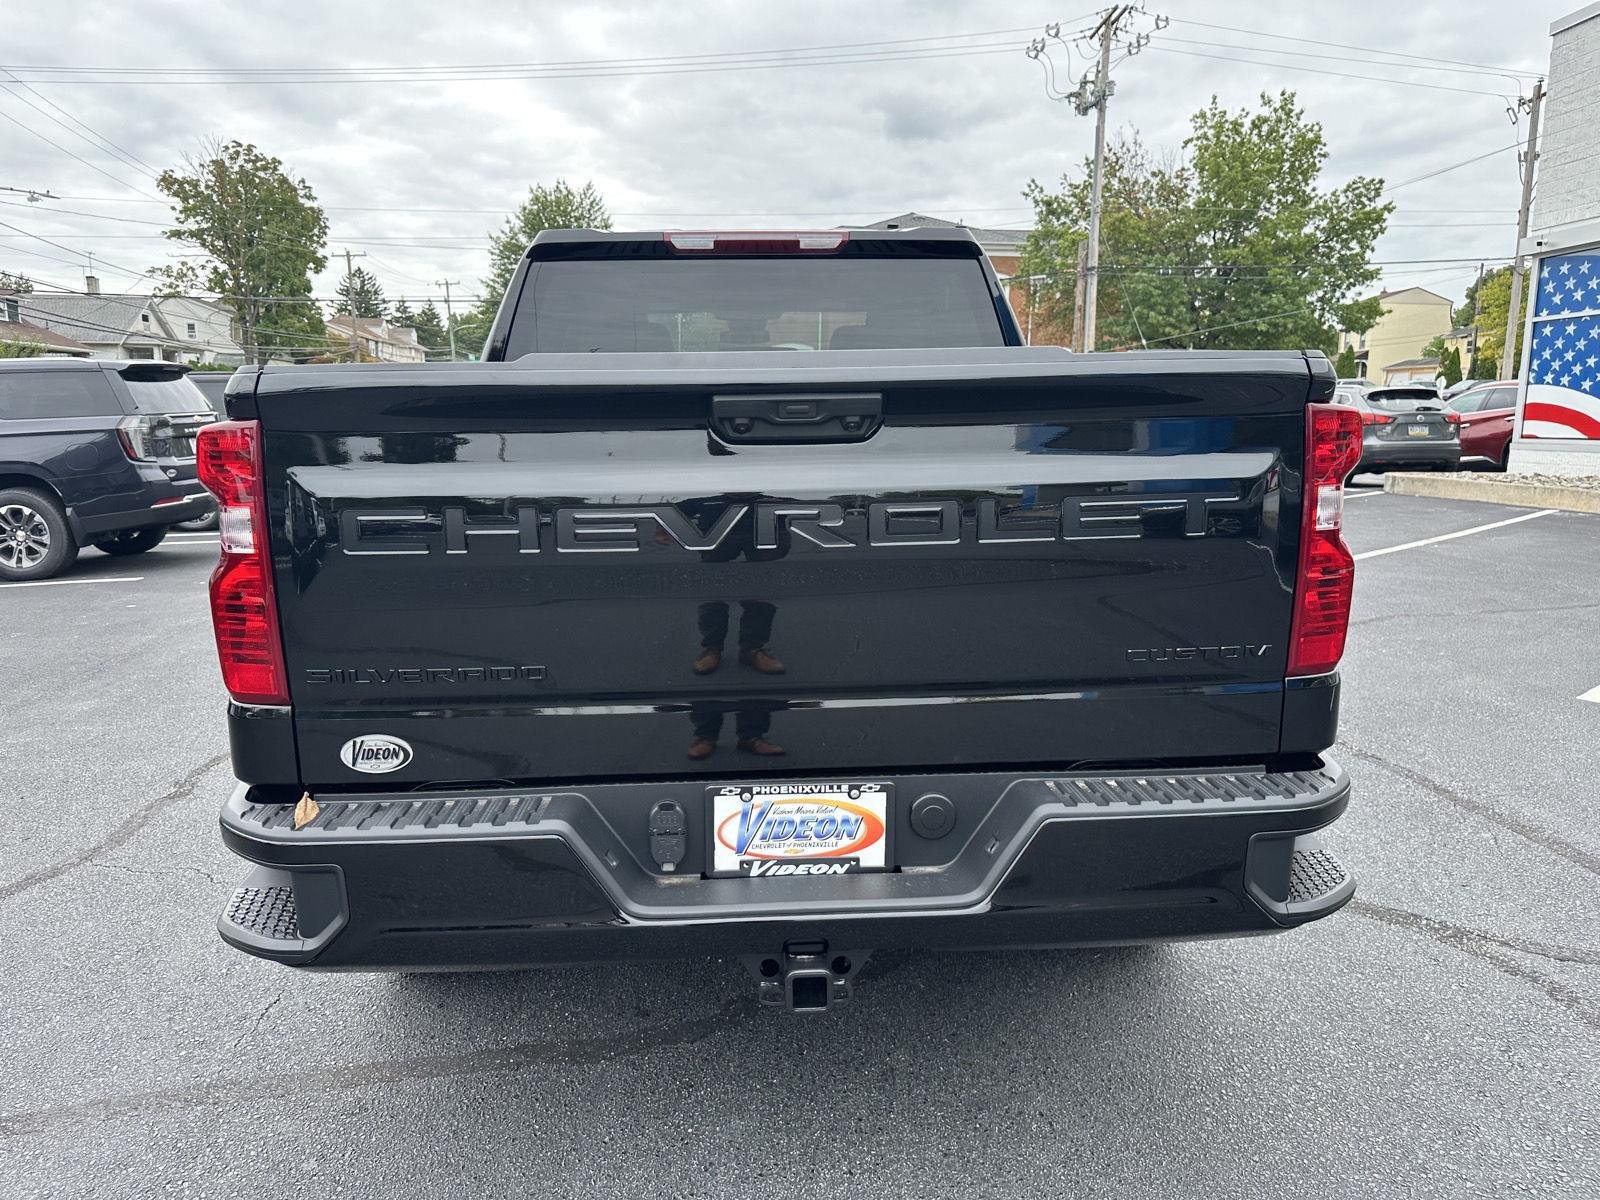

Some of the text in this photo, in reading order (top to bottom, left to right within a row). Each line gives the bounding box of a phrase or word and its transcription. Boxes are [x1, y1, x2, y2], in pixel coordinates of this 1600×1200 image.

[339, 494, 1244, 557] CHEVROLET
[1125, 643, 1273, 663] CUSTOM
[305, 664, 547, 685] SILVERADO
[351, 739, 402, 767] VIDEON
[752, 784, 849, 795] PHOENIXVILLE
[735, 800, 864, 856] VIDEON
[751, 842, 786, 850] CHEVROLET
[793, 841, 839, 849] PHOENIXVILLE
[749, 860, 851, 877] VIDEON
